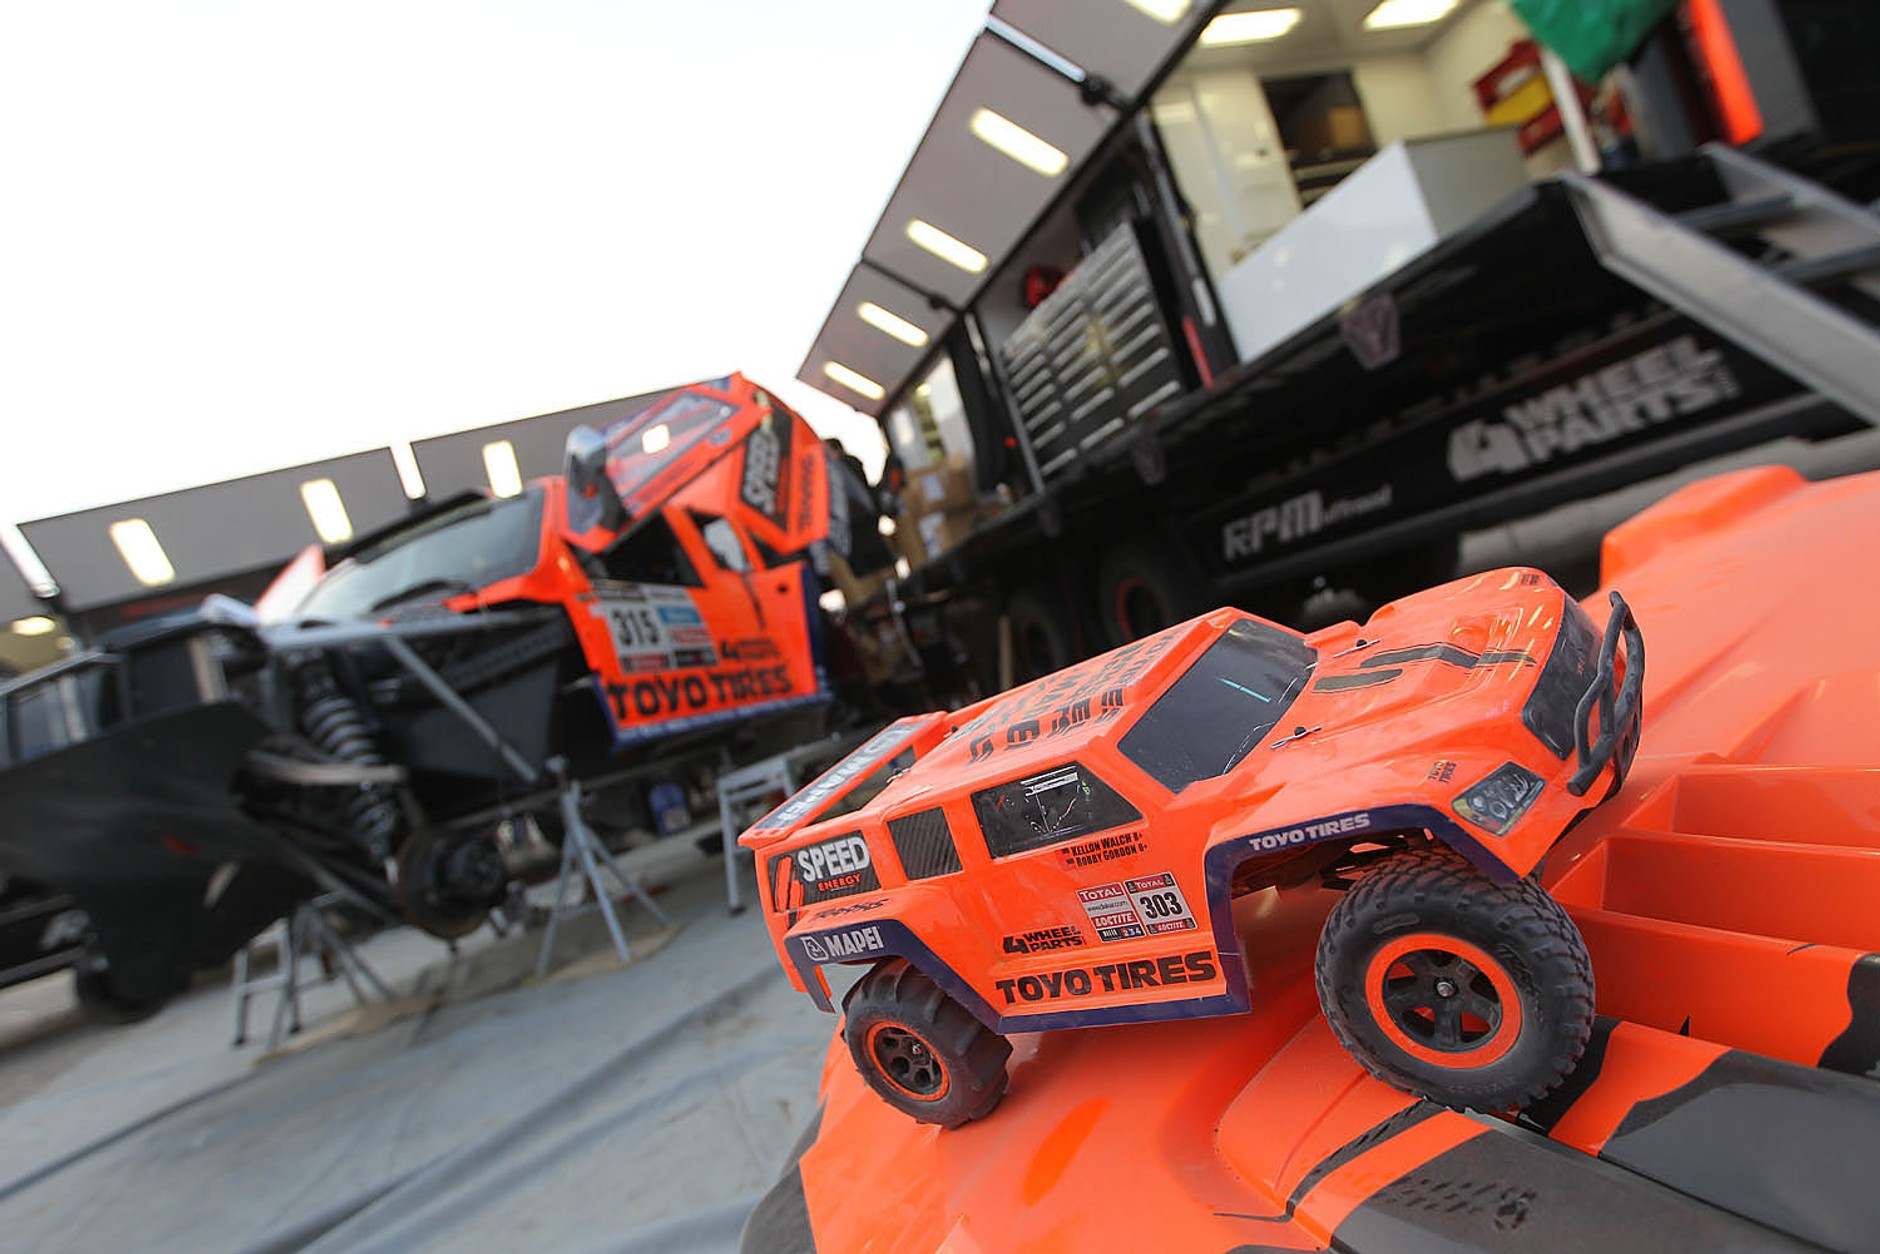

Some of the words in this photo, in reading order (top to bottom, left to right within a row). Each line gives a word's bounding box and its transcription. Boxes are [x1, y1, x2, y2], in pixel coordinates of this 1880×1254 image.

[1223, 489, 1324, 561] RPM
[611, 608, 659, 646] 315
[607, 673, 708, 720] TOYO
[708, 663, 793, 703] TIRES
[1101, 833, 1132, 849] WALCH
[1249, 829, 1306, 851] TOYO
[1305, 813, 1371, 839] TIRES
[797, 836, 871, 882] SPEED
[1103, 844, 1137, 861] GORDON
[818, 873, 862, 892] ENERGY
[1135, 879, 1164, 890] TOTAL
[1095, 912, 1134, 927] LOCTITE
[1139, 892, 1183, 919] 303
[824, 925, 885, 957] MAPEI
[1003, 936, 1030, 954] 4
[1025, 926, 1082, 941] WHEEL
[1028, 936, 1083, 951] PARTS
[996, 969, 1092, 1004] TOYO
[1093, 951, 1217, 992] TIRES
